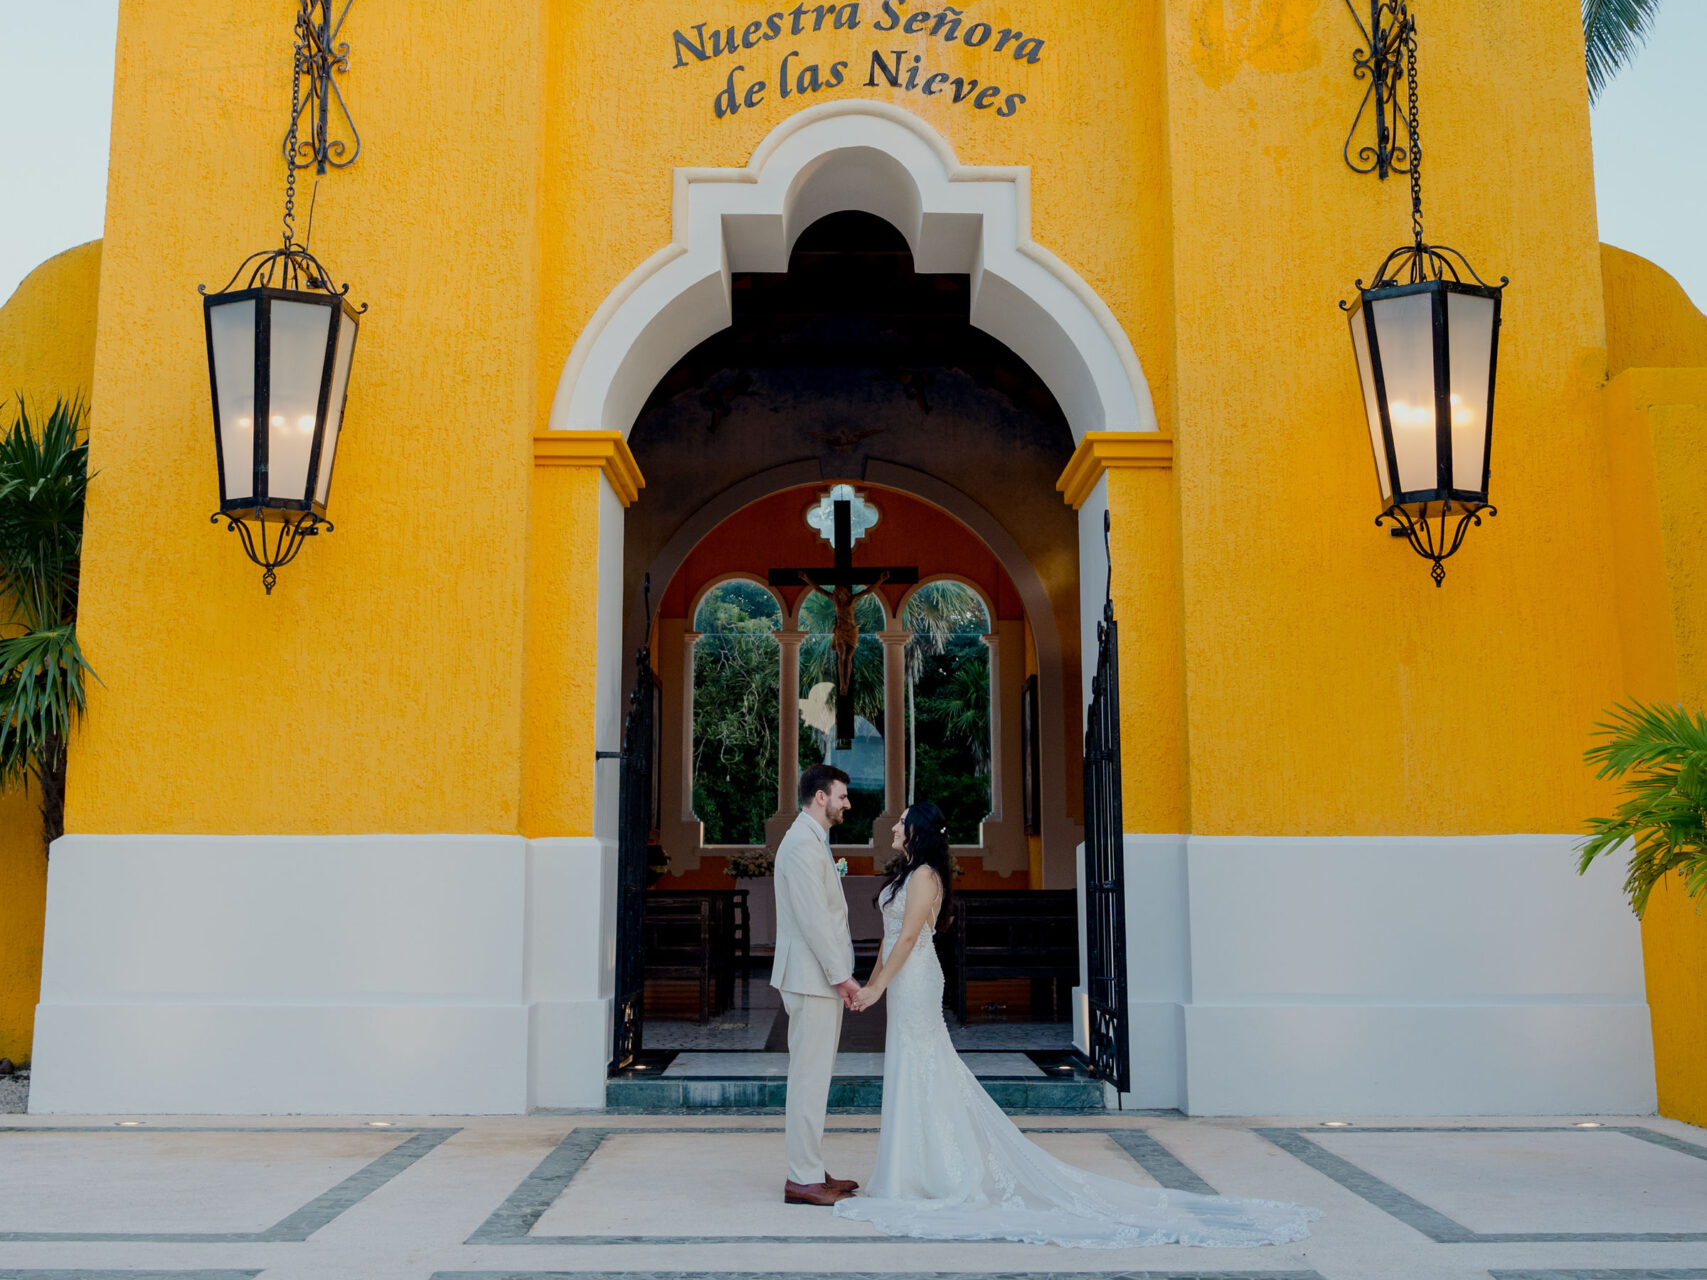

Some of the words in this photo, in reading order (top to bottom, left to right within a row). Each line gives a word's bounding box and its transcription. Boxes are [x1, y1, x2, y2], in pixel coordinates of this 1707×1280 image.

[672, 2, 861, 69] Nuestra
[713, 65, 767, 120] de
[779, 50, 849, 99] las
[863, 49, 1027, 118] Nieves
